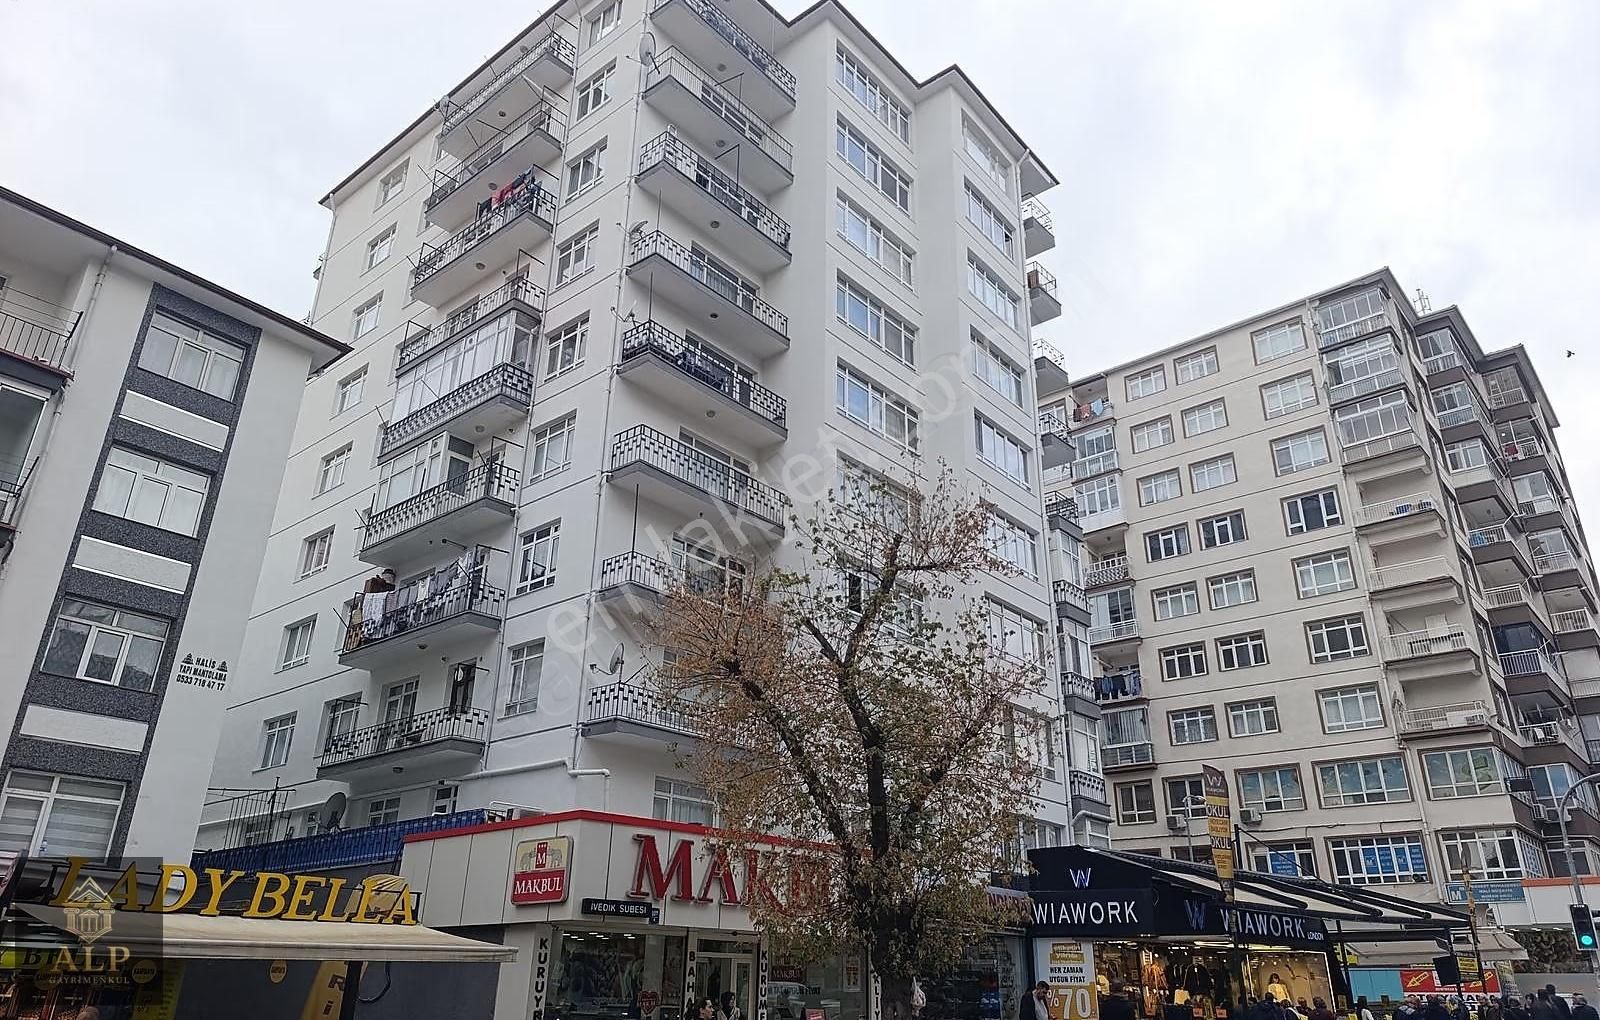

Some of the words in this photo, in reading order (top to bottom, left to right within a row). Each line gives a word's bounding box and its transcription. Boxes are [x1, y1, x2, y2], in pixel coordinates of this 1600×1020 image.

[176, 674, 193, 684] 0533
[206, 680, 215, 689] 47
[216, 682, 225, 691] 17
[1206, 804, 1229, 817] OKUL
[1211, 836, 1231, 849] OKUL
[48, 856, 246, 917] LADY
[242, 871, 419, 926] BELLA
[514, 876, 562, 894] MAKBUL
[1032, 900, 1139, 925] WIAWORK
[1220, 908, 1306, 939] WIAWORK
[1062, 966, 1083, 974] ZAMAN
